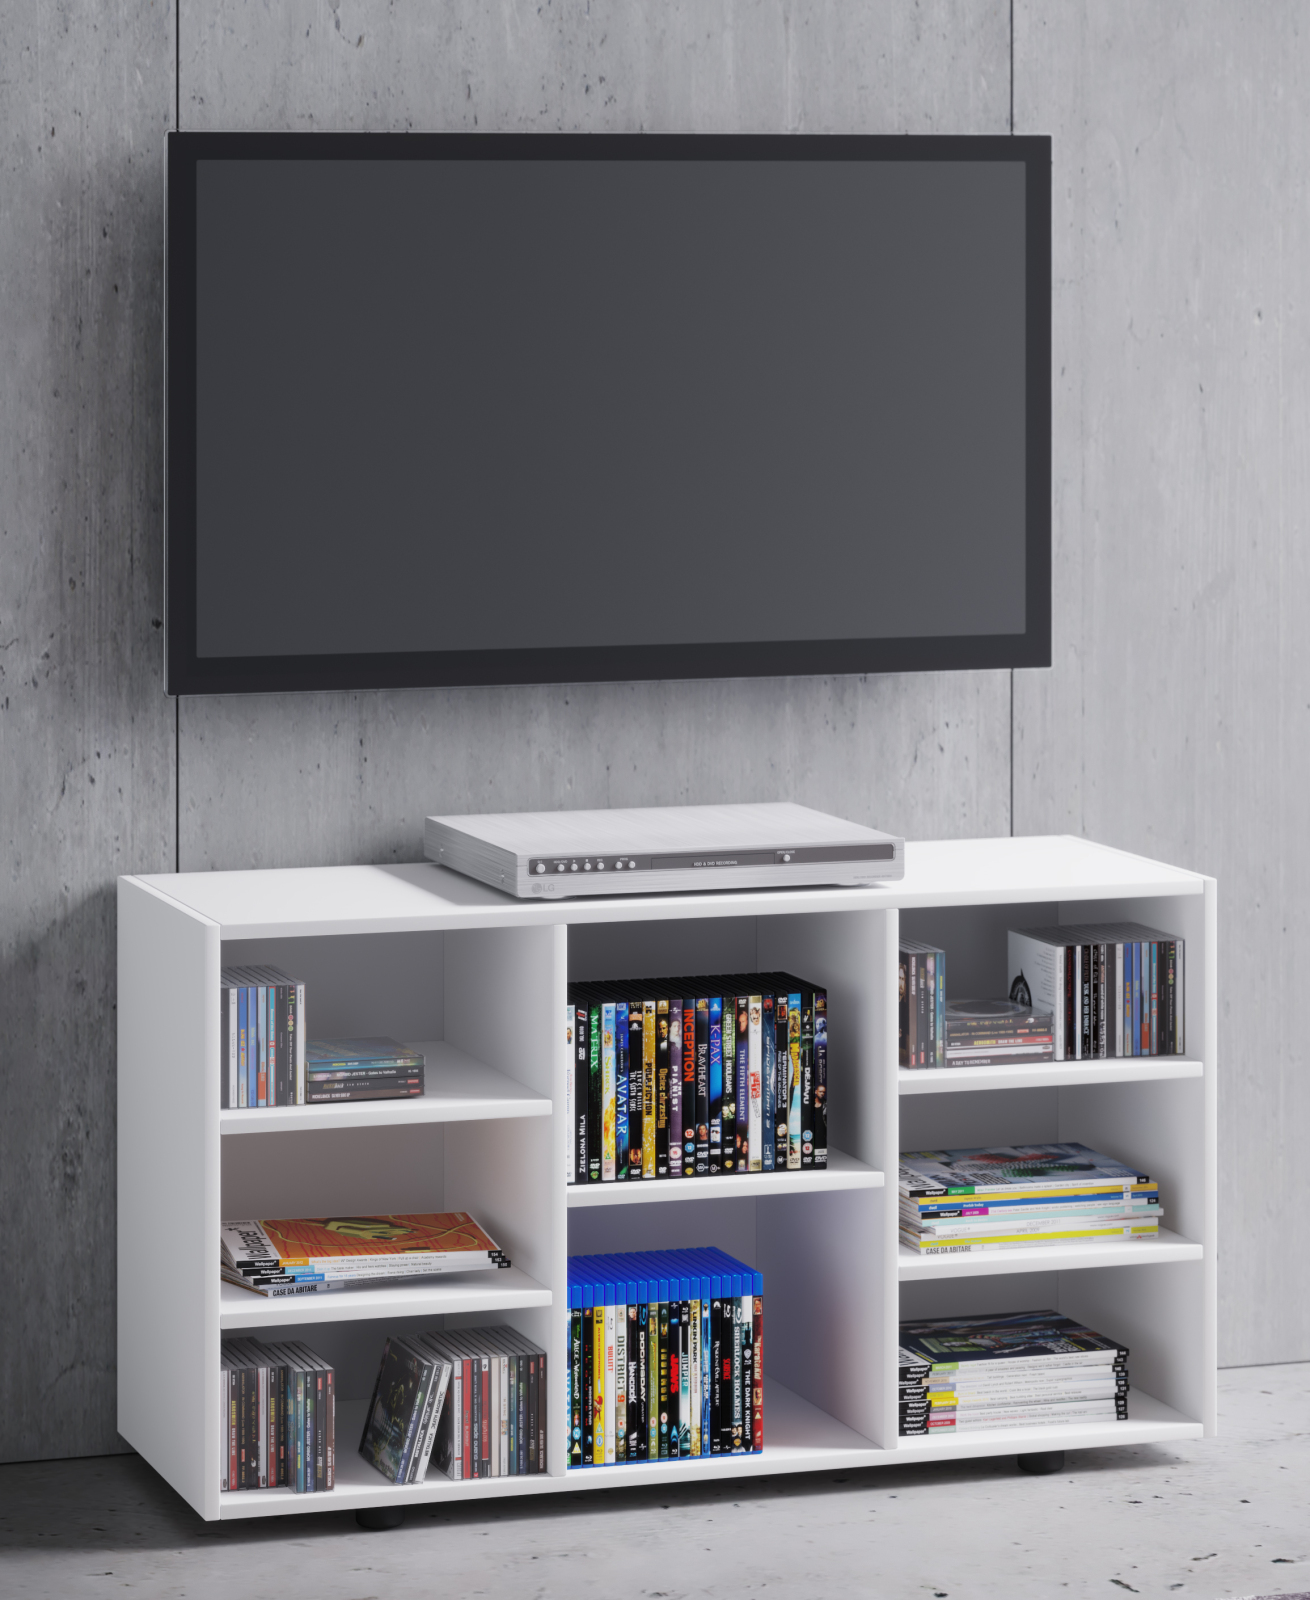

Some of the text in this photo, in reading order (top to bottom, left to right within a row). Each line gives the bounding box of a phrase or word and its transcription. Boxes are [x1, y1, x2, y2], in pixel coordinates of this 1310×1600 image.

[543, 884, 554, 892] LG
[684, 1009, 694, 1082] INCEPTION
[711, 1024, 721, 1066] K-PAX
[698, 1044, 707, 1097] BRAVEHEART
[617, 1074, 627, 1136] AVATAR
[273, 1288, 286, 1296] CASE
[295, 1284, 317, 1293] ABITARE
[670, 1354, 678, 1393] JAWS
[617, 1394, 625, 1403] 9
[414, 1429, 424, 1458] METALLICA
[424, 1433, 433, 1456] METALLICA
[435, 1391, 444, 1414] MAGNETIC
